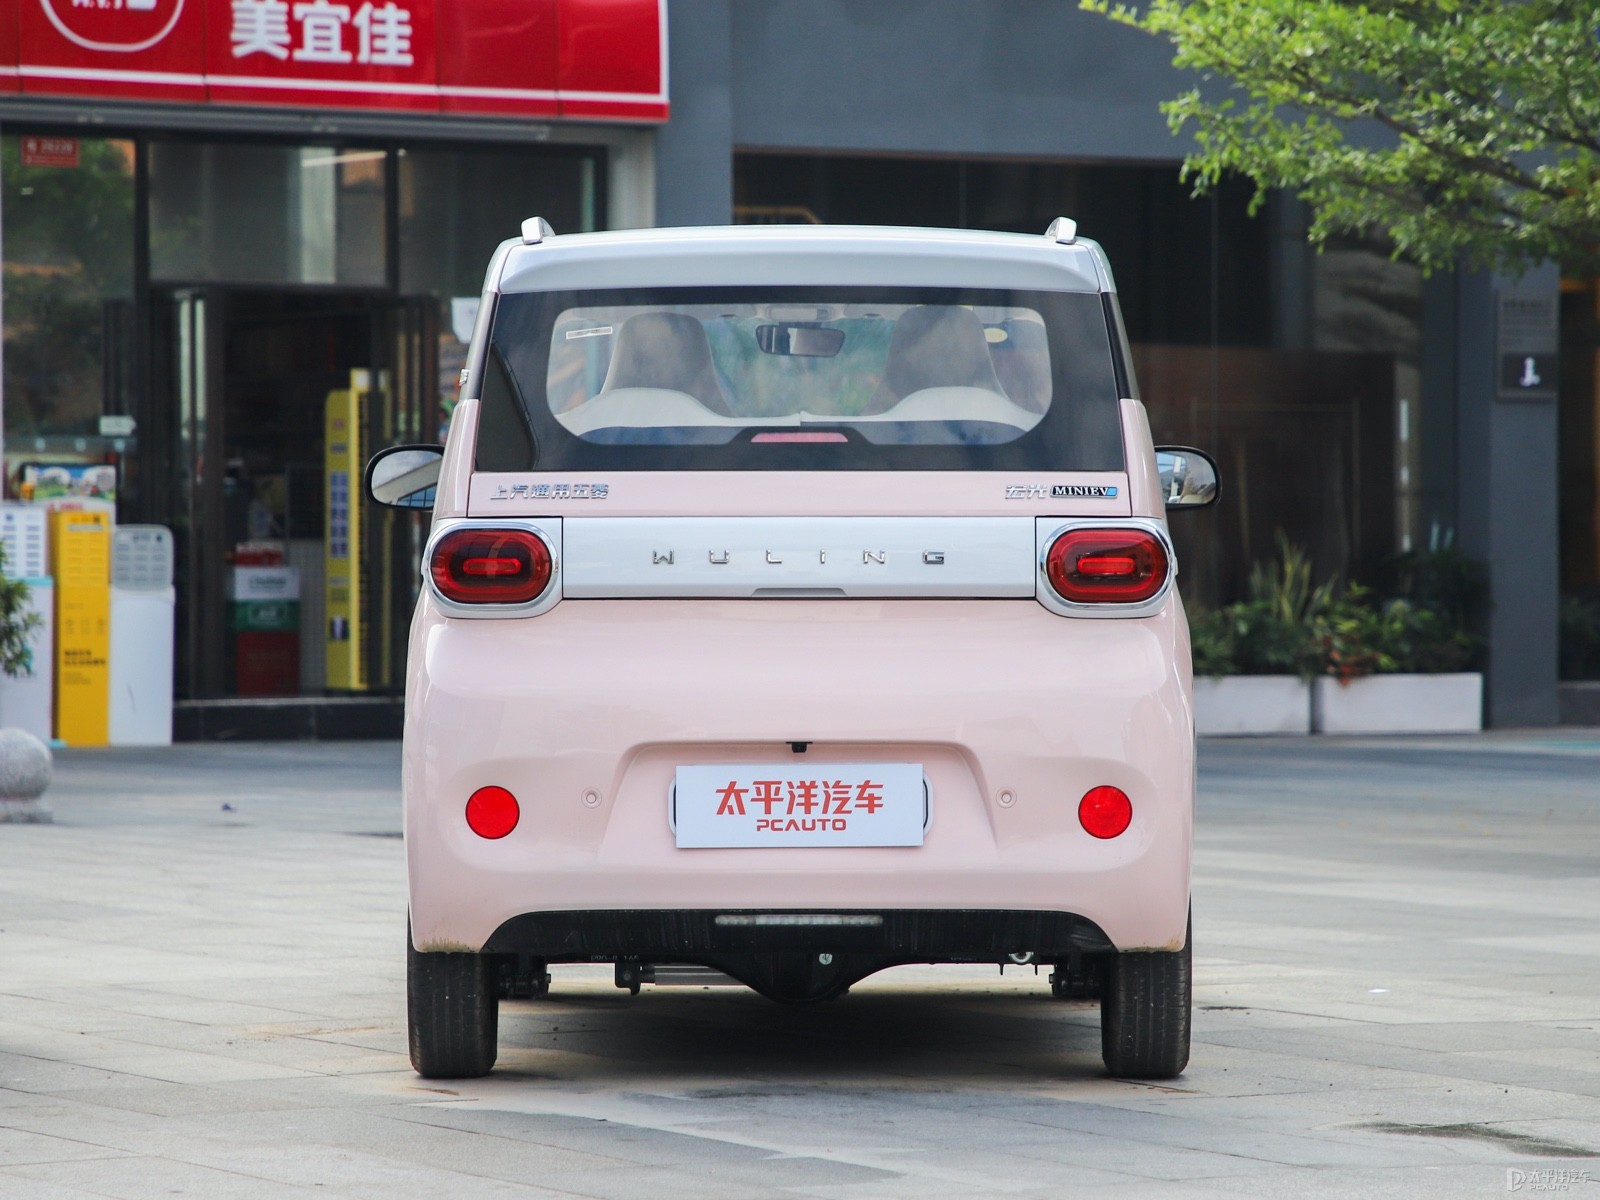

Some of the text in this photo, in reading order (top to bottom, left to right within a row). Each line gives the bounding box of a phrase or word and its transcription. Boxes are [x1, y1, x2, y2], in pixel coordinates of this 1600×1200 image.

[230, 0, 415, 67] 美宜佳
[490, 483, 609, 500] 上汽通用五菱
[1005, 484, 1109, 500] 宏光 MINIEV
[652, 550, 945, 565] WULING
[715, 780, 884, 815] 太平洋汽车
[756, 819, 847, 831] PCAUTO
